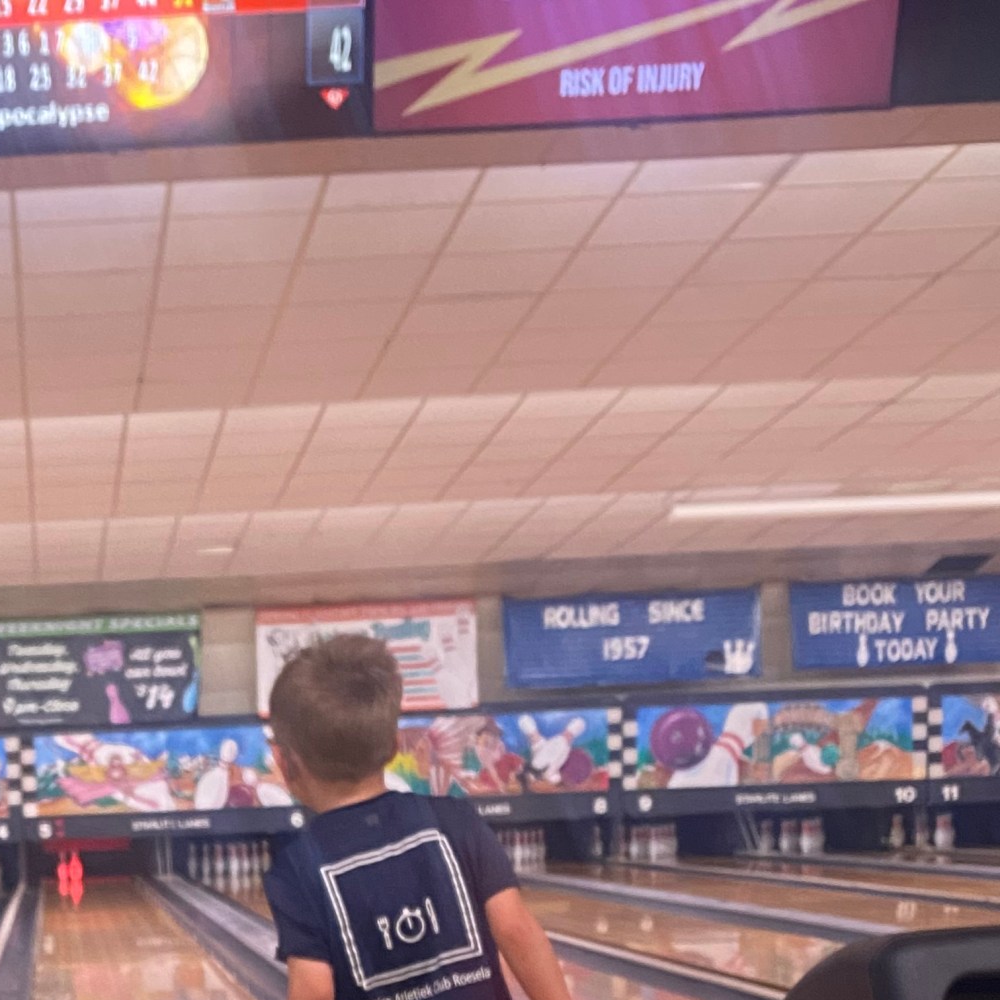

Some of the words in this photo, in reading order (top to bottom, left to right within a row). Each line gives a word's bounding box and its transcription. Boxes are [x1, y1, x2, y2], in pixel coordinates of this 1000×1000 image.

[560, 67, 605, 97] RISK
[608, 65, 634, 95] OF
[636, 61, 705, 94] INJURY
[842, 583, 896, 606] BOOK
[914, 580, 965, 603] YOUR
[543, 603, 620, 629] ROLLING
[648, 599, 705, 625] SINCE
[808, 610, 905, 635] BIRTHDAY
[926, 608, 990, 631] PARTY
[602, 637, 650, 661] 1957
[875, 637, 938, 662] TODAY
[894, 786, 918, 804] 10
[941, 784, 960, 802] 11
